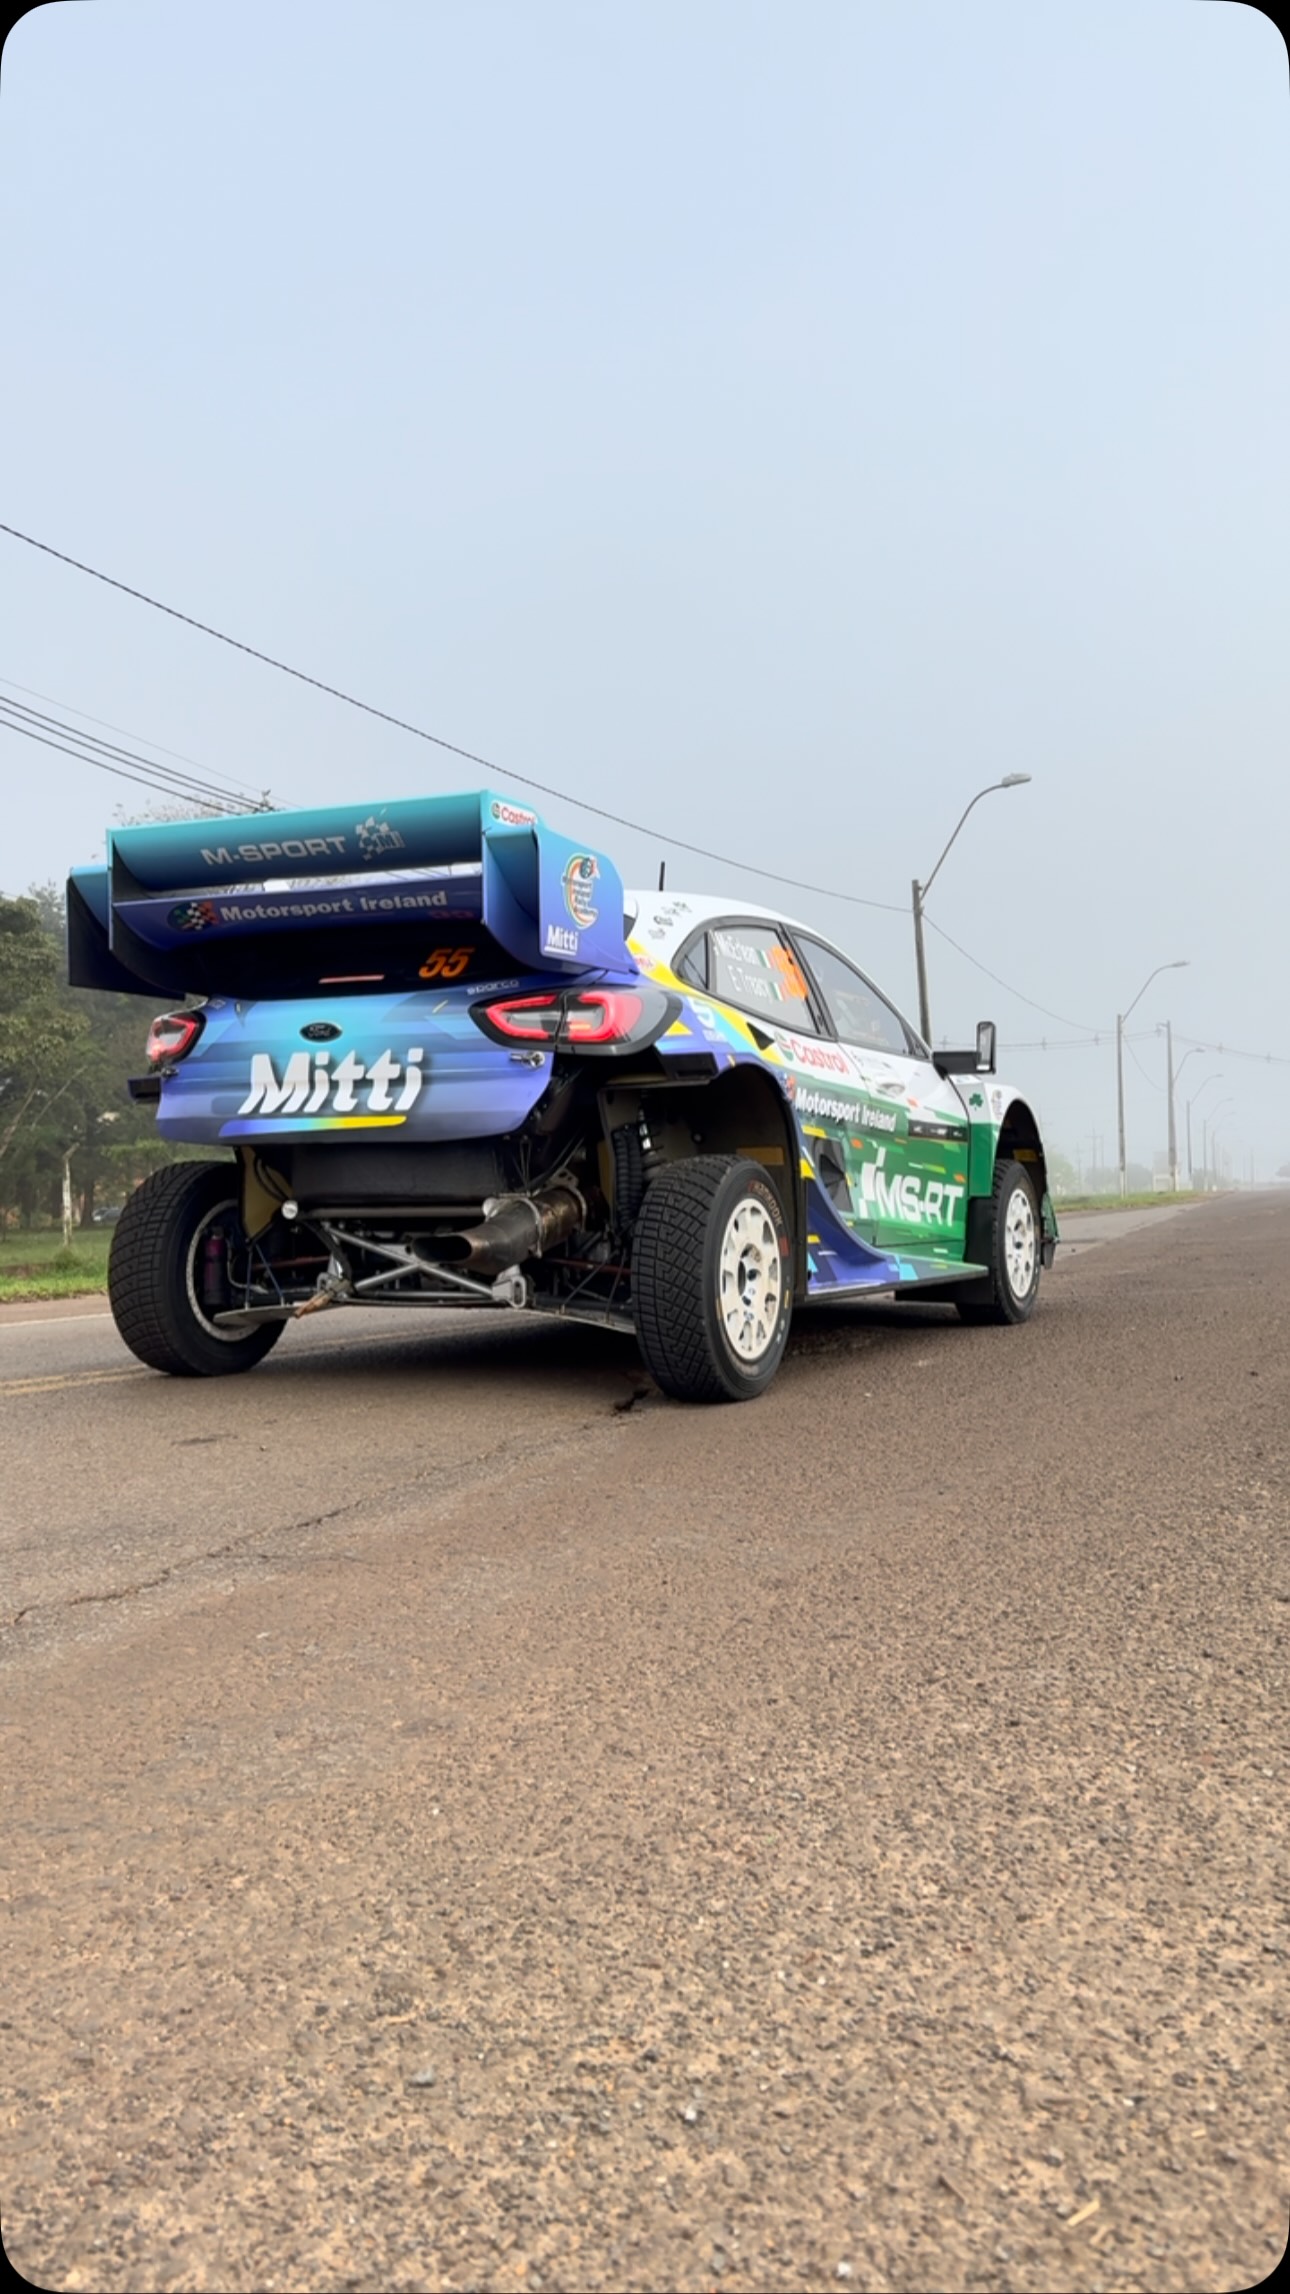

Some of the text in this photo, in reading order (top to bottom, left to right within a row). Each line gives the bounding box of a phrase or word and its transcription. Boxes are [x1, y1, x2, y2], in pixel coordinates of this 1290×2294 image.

[202, 836, 346, 866] M-SPORT
[220, 890, 447, 922] Motorsport Ireland
[547, 924, 579, 951] Mitti
[419, 947, 475, 978] 55
[790, 1039, 849, 1074] Castrol
[238, 1048, 424, 1114] Mitti
[795, 1087, 897, 1132] Motorsport Ireland
